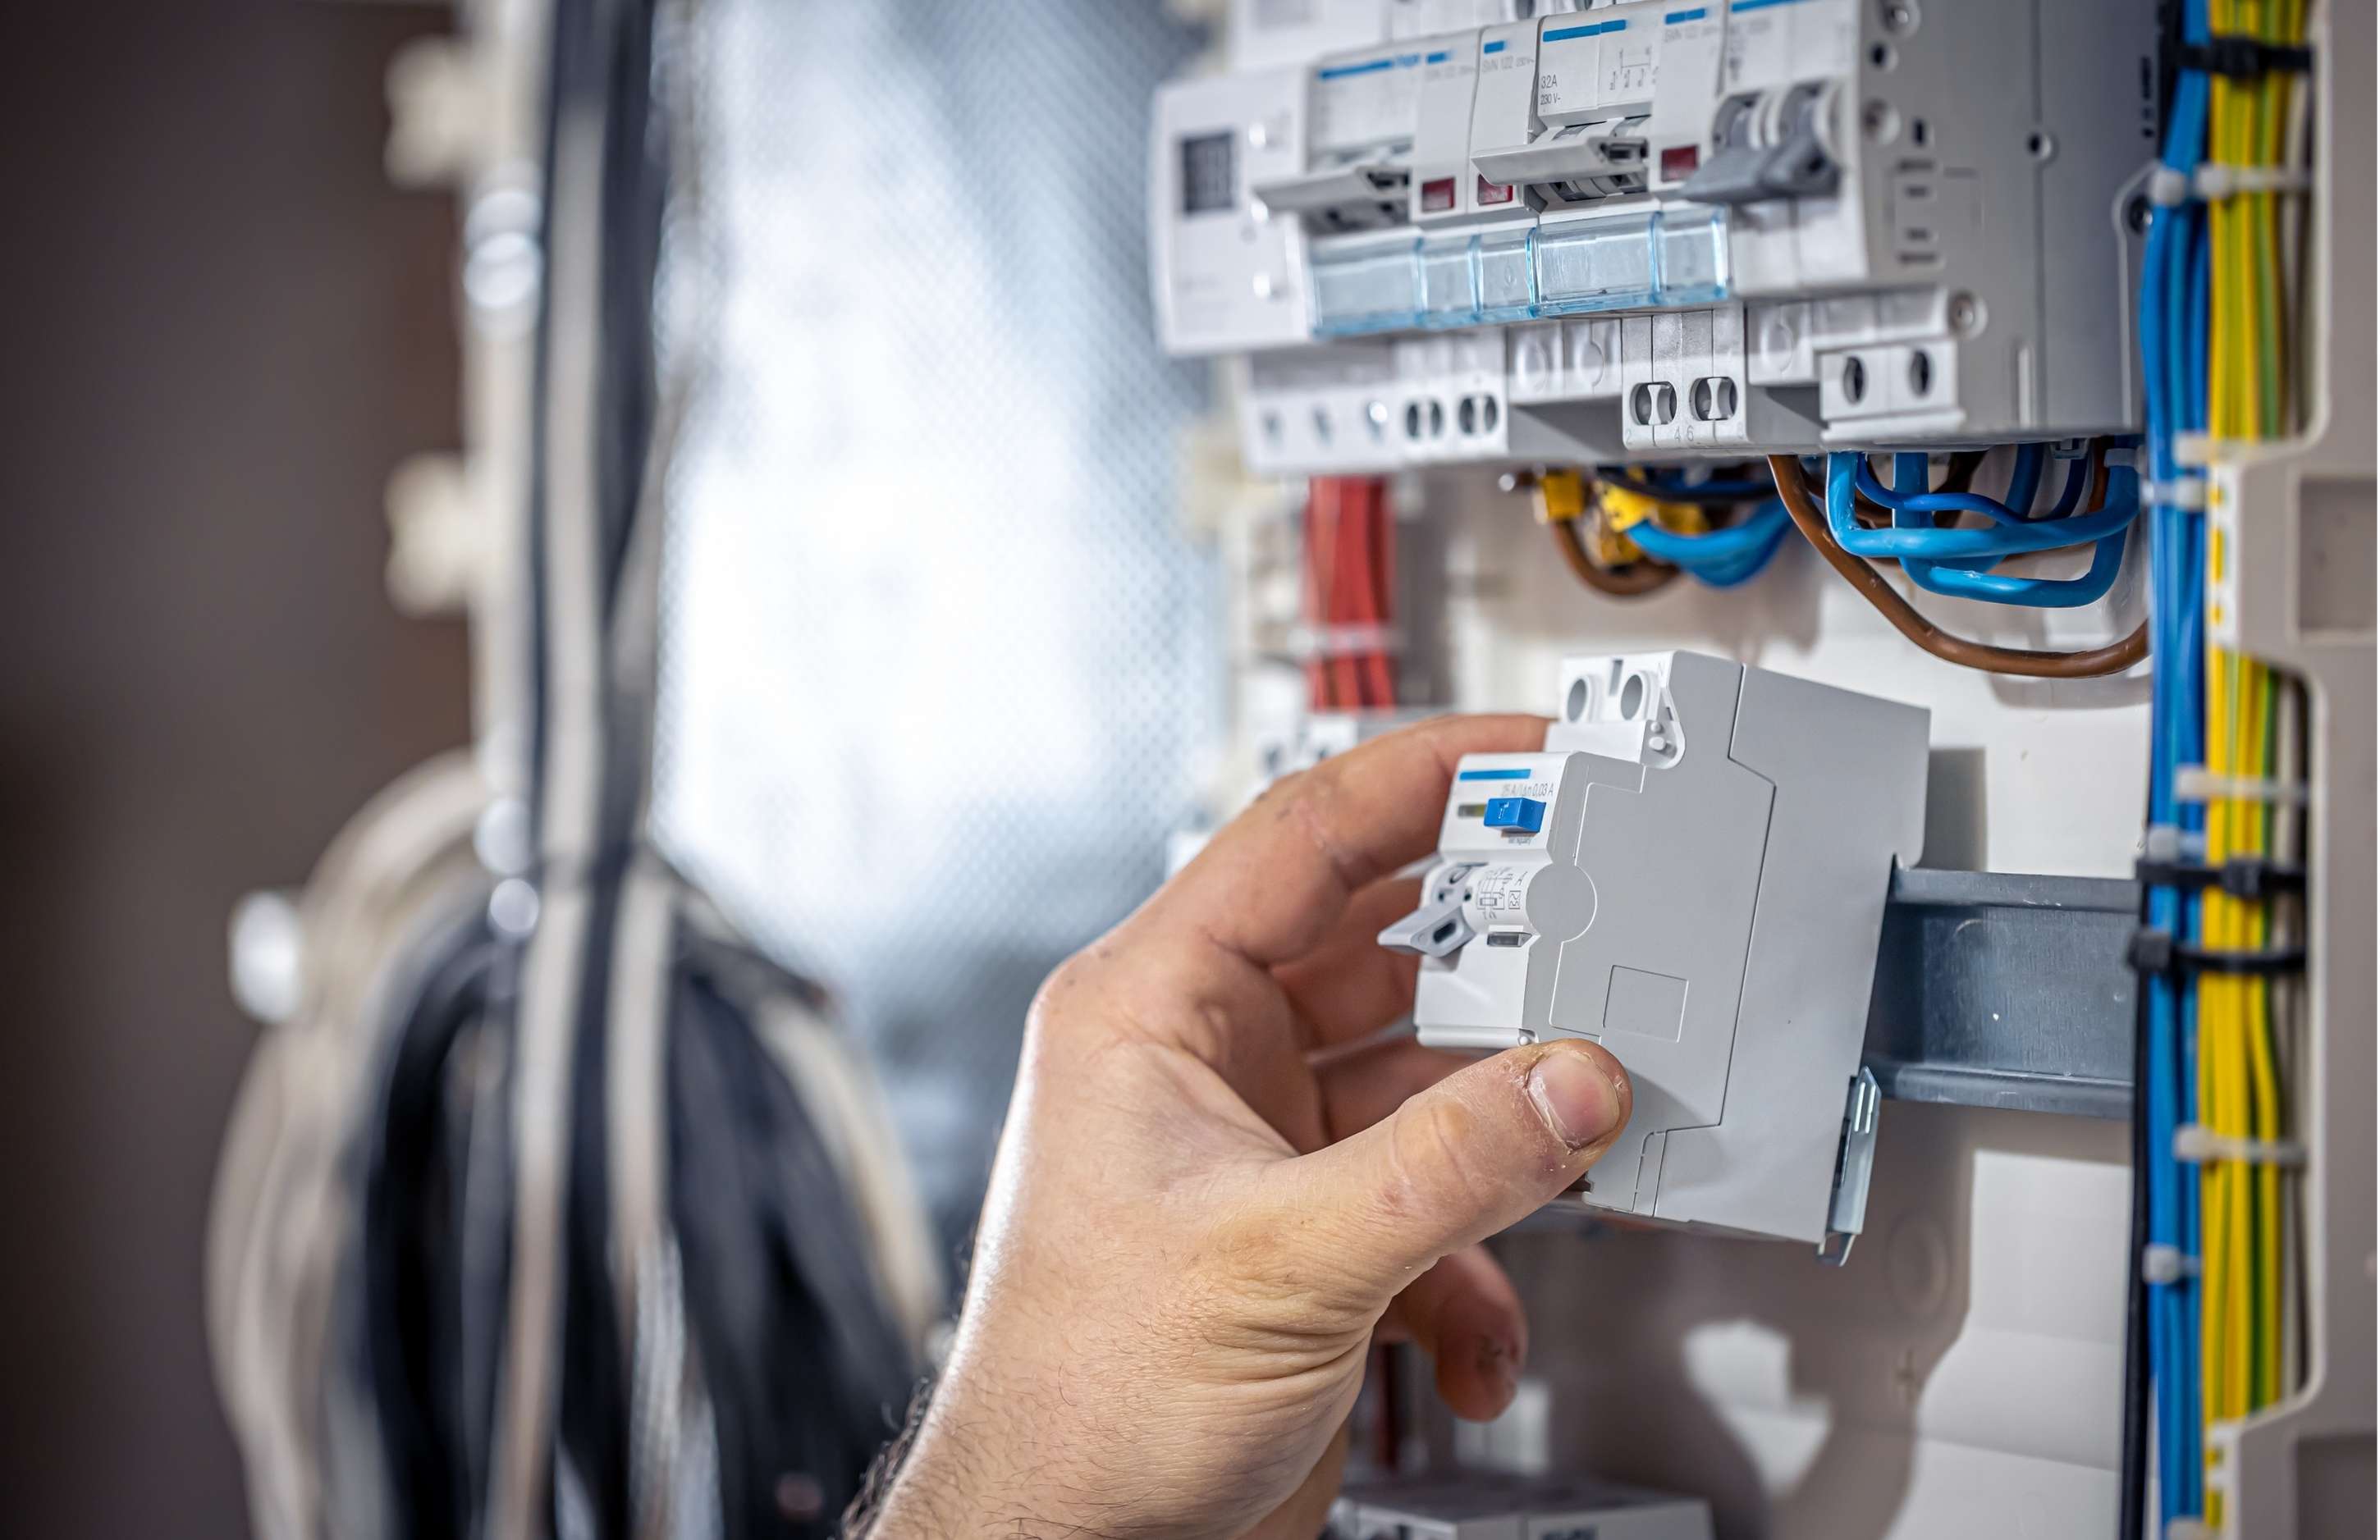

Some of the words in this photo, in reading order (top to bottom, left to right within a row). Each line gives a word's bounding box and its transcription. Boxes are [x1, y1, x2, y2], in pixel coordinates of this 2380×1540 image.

[1541, 74, 1558, 89] 32A
[1674, 426, 1681, 443] 4
[1687, 425, 1695, 442] 6
